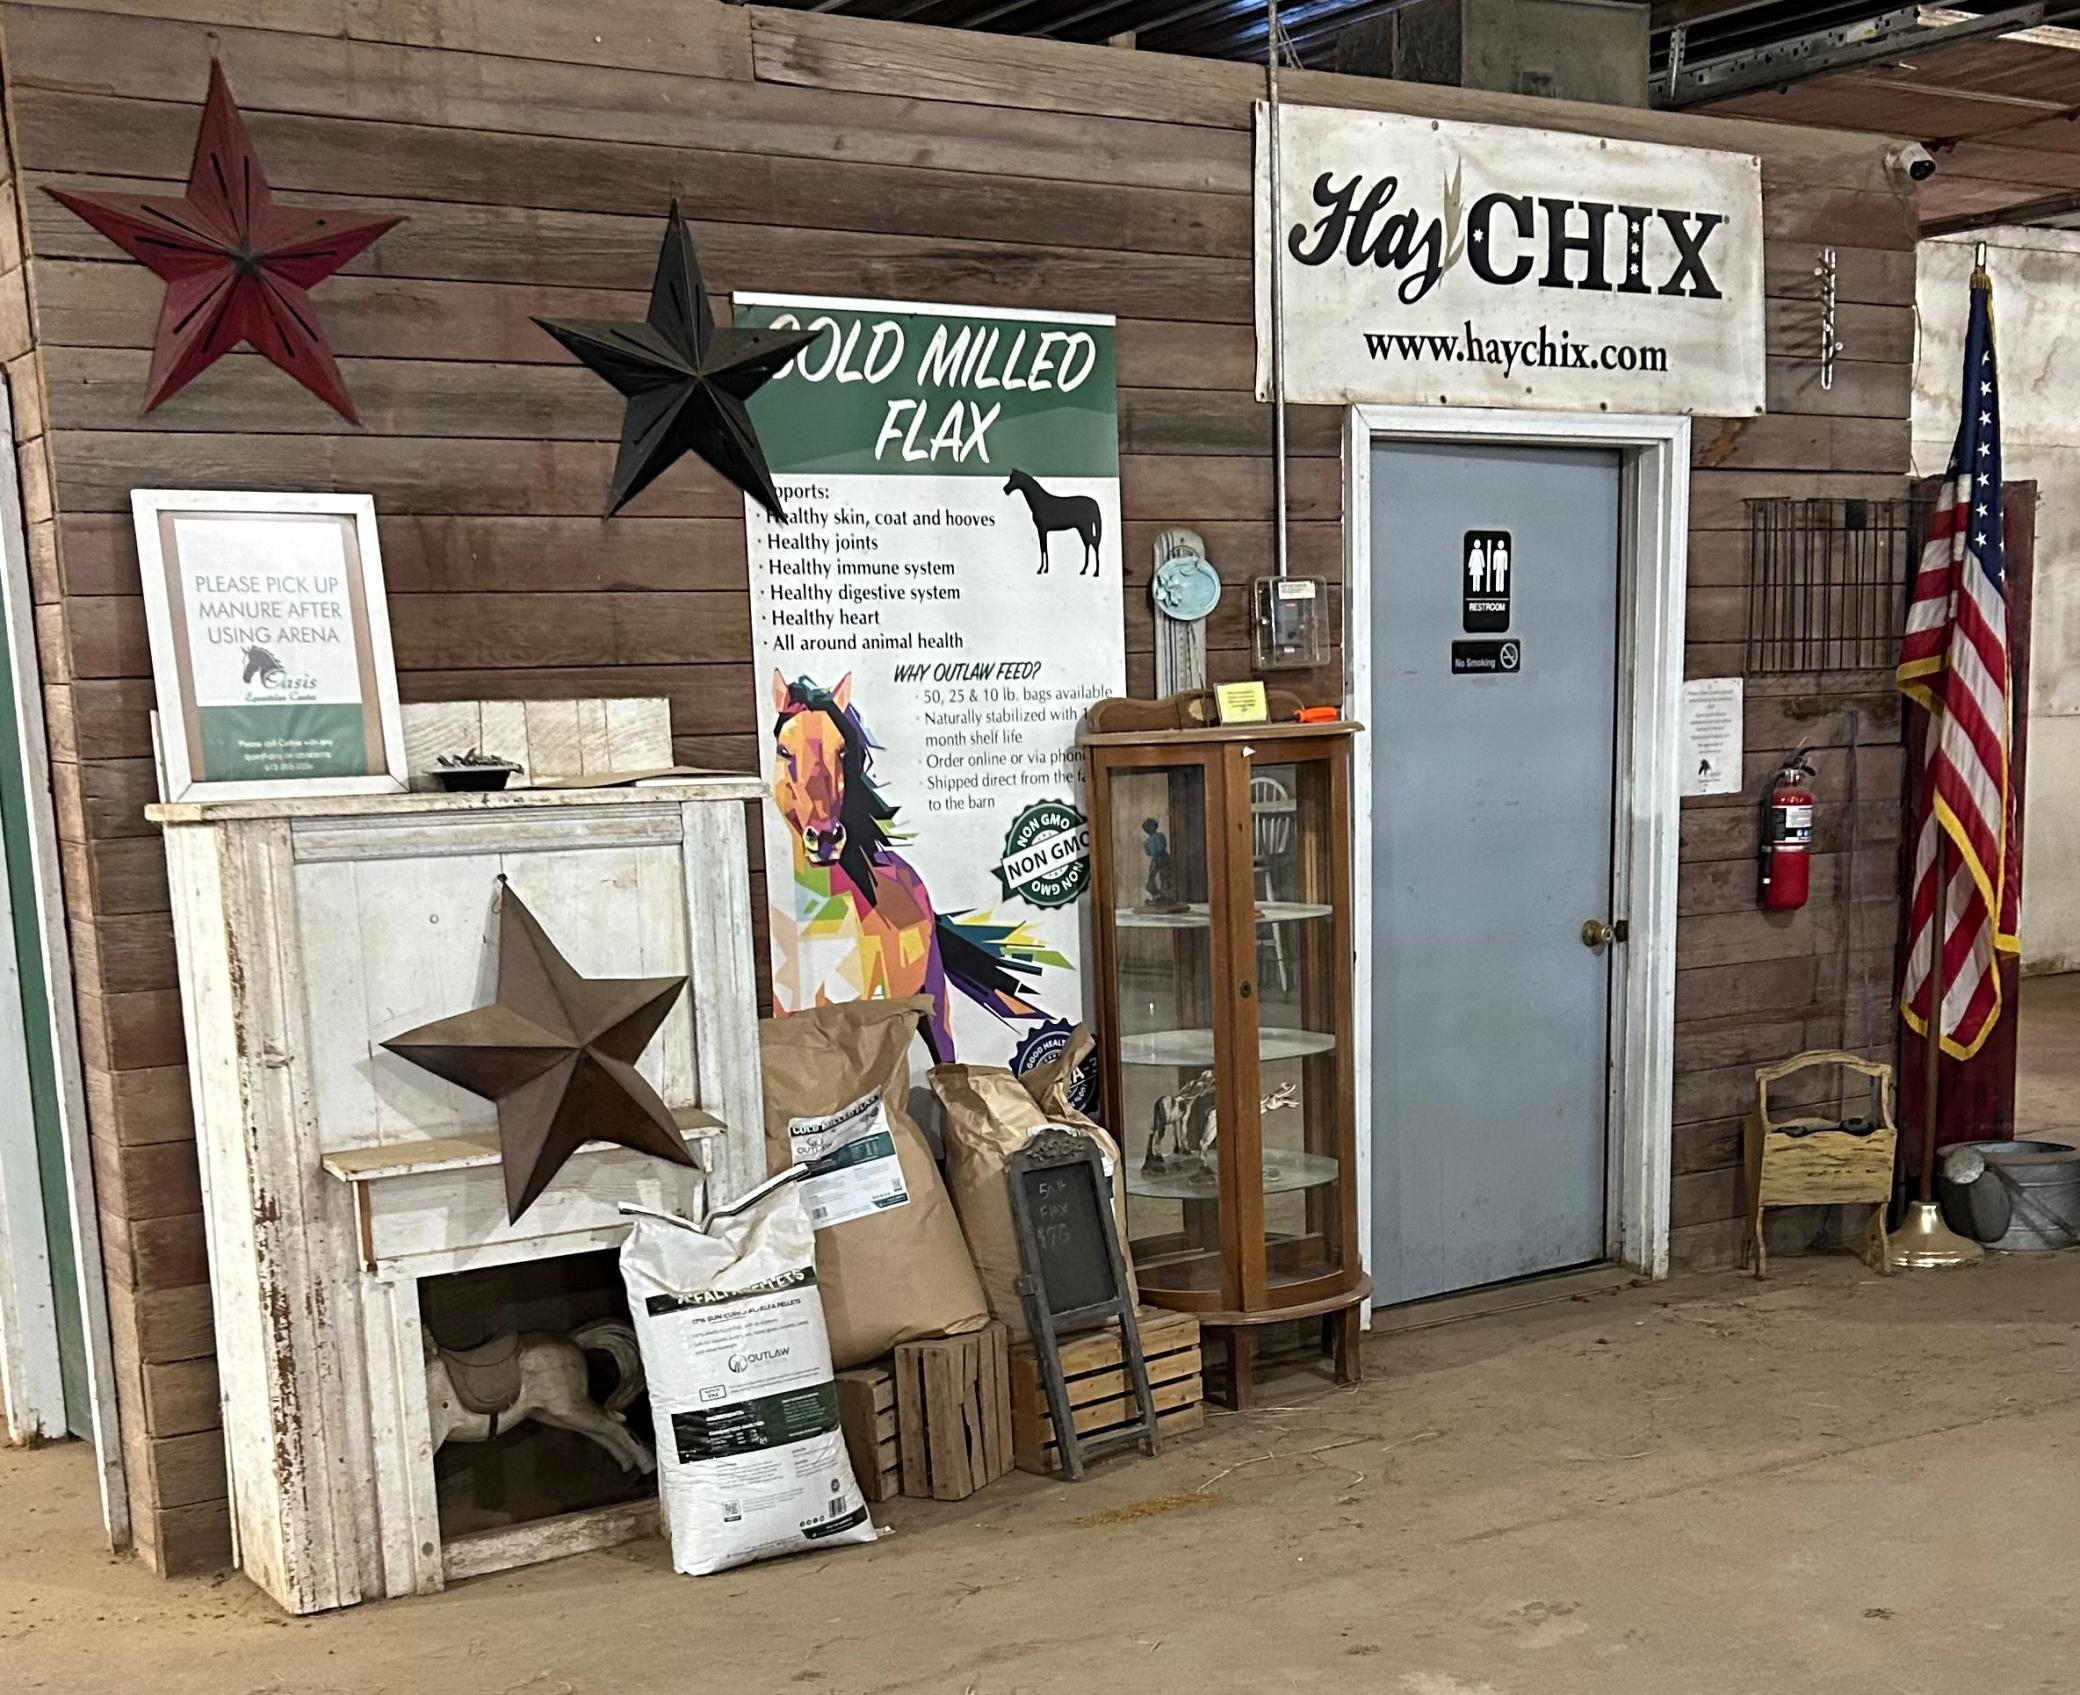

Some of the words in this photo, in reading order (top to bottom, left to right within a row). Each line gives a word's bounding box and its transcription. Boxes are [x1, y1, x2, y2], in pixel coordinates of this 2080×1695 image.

[1287, 171, 1446, 305] Hay
[1467, 192, 1723, 300] CHIX
[917, 323, 1096, 392] MILLED
[1363, 320, 1668, 378] www.haychix.com
[874, 398, 1001, 464] FLAX
[774, 484, 830, 502] pports:
[834, 508, 870, 528] skin,
[875, 511, 908, 525] coat
[912, 508, 939, 526] and
[945, 508, 996, 528] hooves
[768, 533, 830, 554] Healthy
[836, 533, 878, 553] joints
[769, 558, 831, 579] Healthy
[837, 558, 900, 575] immune
[904, 561, 955, 580] system
[195, 575, 260, 593] PLEASE
[266, 575, 309, 594] PICK
[314, 576, 339, 594] UP
[770, 584, 832, 604] Healthy
[838, 584, 905, 604] digestive
[910, 586, 961, 604] system
[199, 601, 282, 618] MANURE
[287, 601, 342, 618] AFTER
[1468, 602, 1506, 612] RESTROOM
[771, 609, 835, 629] Healthy
[840, 610, 880, 625] heart
[207, 626, 271, 645] USING
[277, 626, 340, 644] ARENA
[773, 634, 794, 651] All
[800, 634, 857, 650] around
[862, 633, 913, 650] animal
[918, 633, 963, 649] health
[894, 663, 931, 683] WHY
[933, 662, 996, 681] OUTLAW
[996, 661, 1042, 680] FEED?
[1455, 658, 1465, 668] No
[1466, 657, 1496, 669] Smoking
[924, 689, 944, 705] 50,
[949, 689, 965, 703] 25
[969, 688, 978, 702] &
[983, 688, 999, 701] 10
[1003, 686, 1020, 701] lb.
[1023, 686, 1052, 704] bags
[1055, 684, 1113, 700] available
[925, 710, 982, 728] Naturally
[986, 708, 1046, 724] stabilized
[1050, 707, 1078, 720] with
[925, 731, 966, 747] month
[970, 730, 999, 745] shelf
[1002, 729, 1023, 744] life
[926, 753, 964, 769] Order
[967, 750, 1007, 766] online
[1010, 752, 1024, 765] or
[1027, 749, 1046, 764] via
[927, 775, 979, 792] Shipped
[981, 771, 1017, 787] direct
[1020, 770, 1050, 785] from
[1054, 768, 1073, 783] the
[928, 799, 942, 811] to
[945, 797, 965, 811] the
[968, 796, 995, 809] barn
[1016, 818, 1041, 848] NON
[1040, 813, 1070, 830] GMO
[1008, 850, 1048, 880] NON
[1051, 831, 1090, 860] GMO
[1061, 861, 1084, 891] NON
[1031, 880, 1061, 896] GMO
[1026, 1046, 1044, 1070] GOOD
[1042, 1039, 1067, 1051] HEALT
[747, 1347, 790, 1363] OUTLAW
